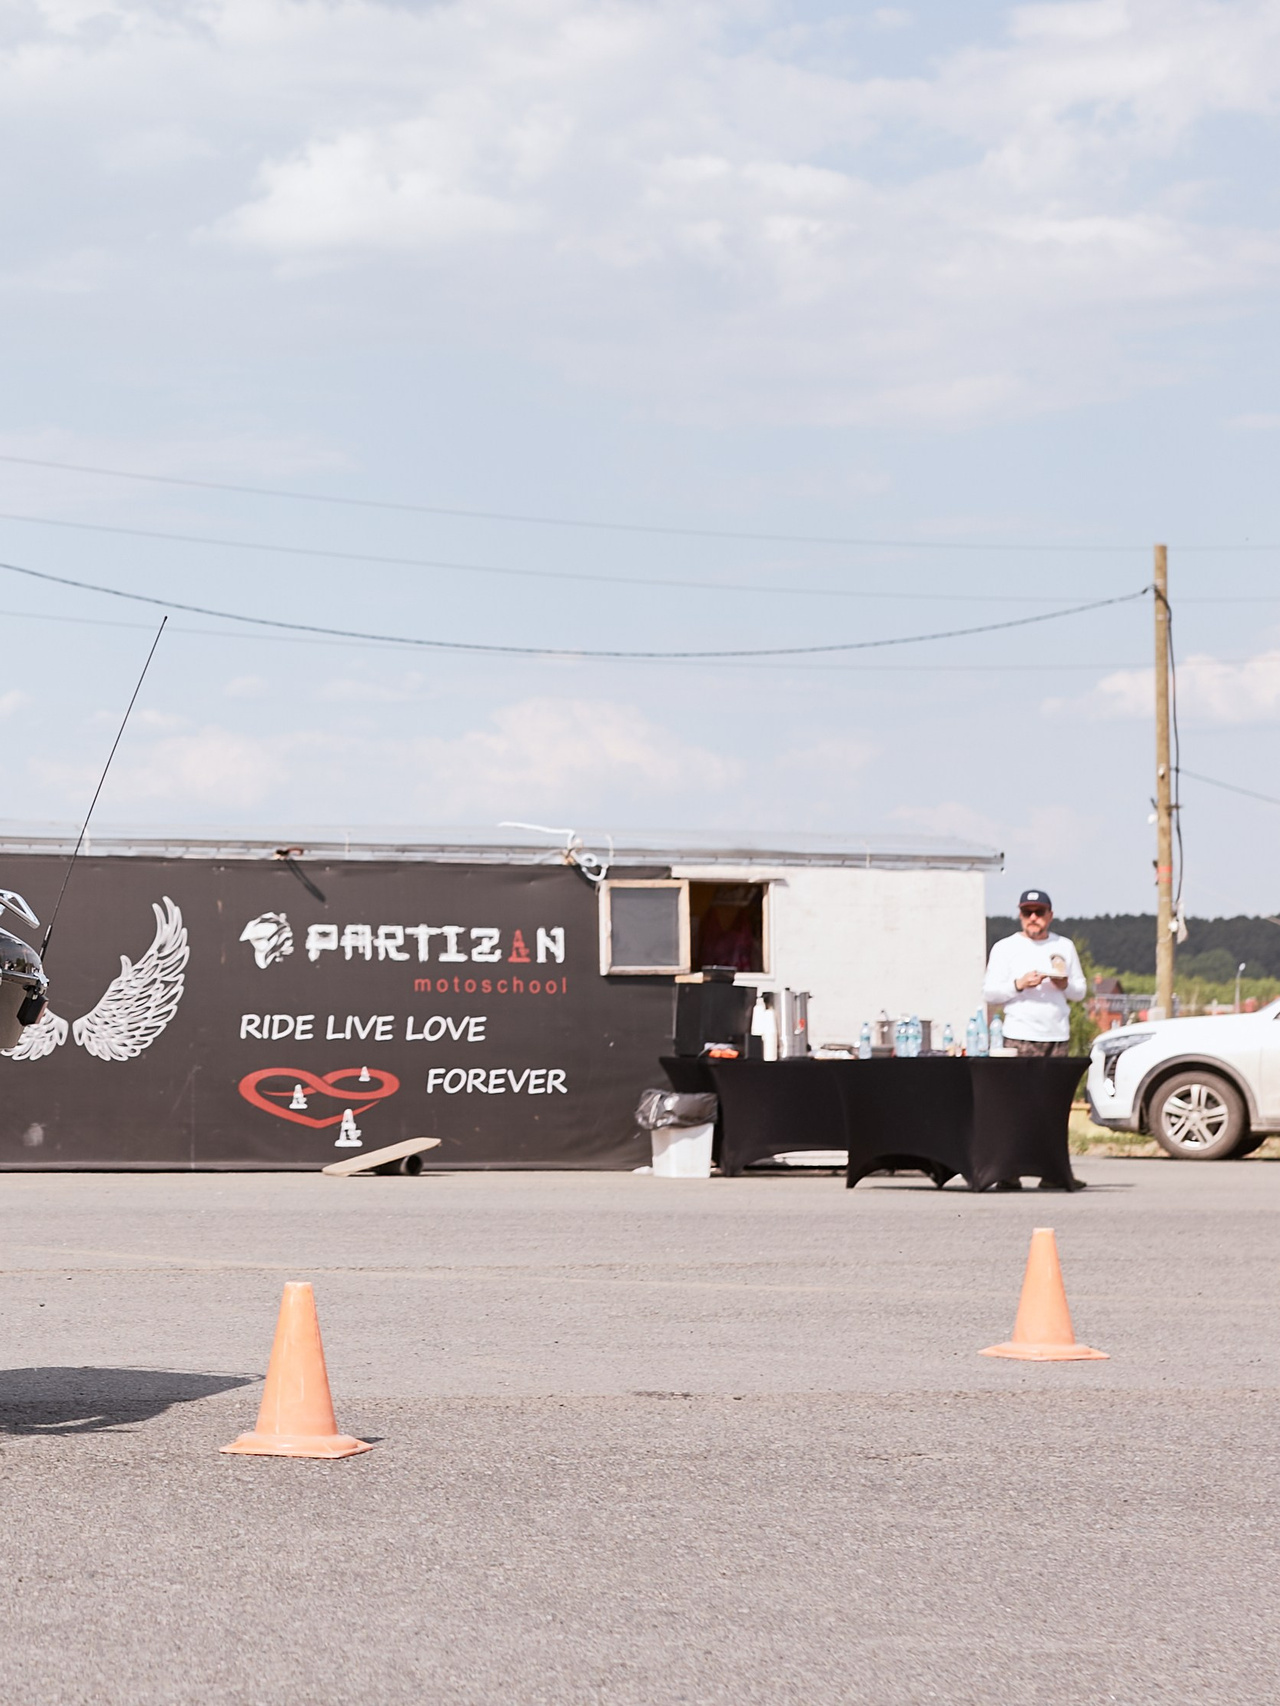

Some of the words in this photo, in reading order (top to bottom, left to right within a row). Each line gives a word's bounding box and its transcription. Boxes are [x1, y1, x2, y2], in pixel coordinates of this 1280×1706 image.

[305, 923, 565, 963] PARTIZAN
[413, 976, 568, 994] motoschool
[239, 1014, 315, 1040] RIDE
[325, 1015, 395, 1041] LIVE
[405, 1015, 487, 1042] LOVE
[426, 1067, 568, 1095] FOREVER
